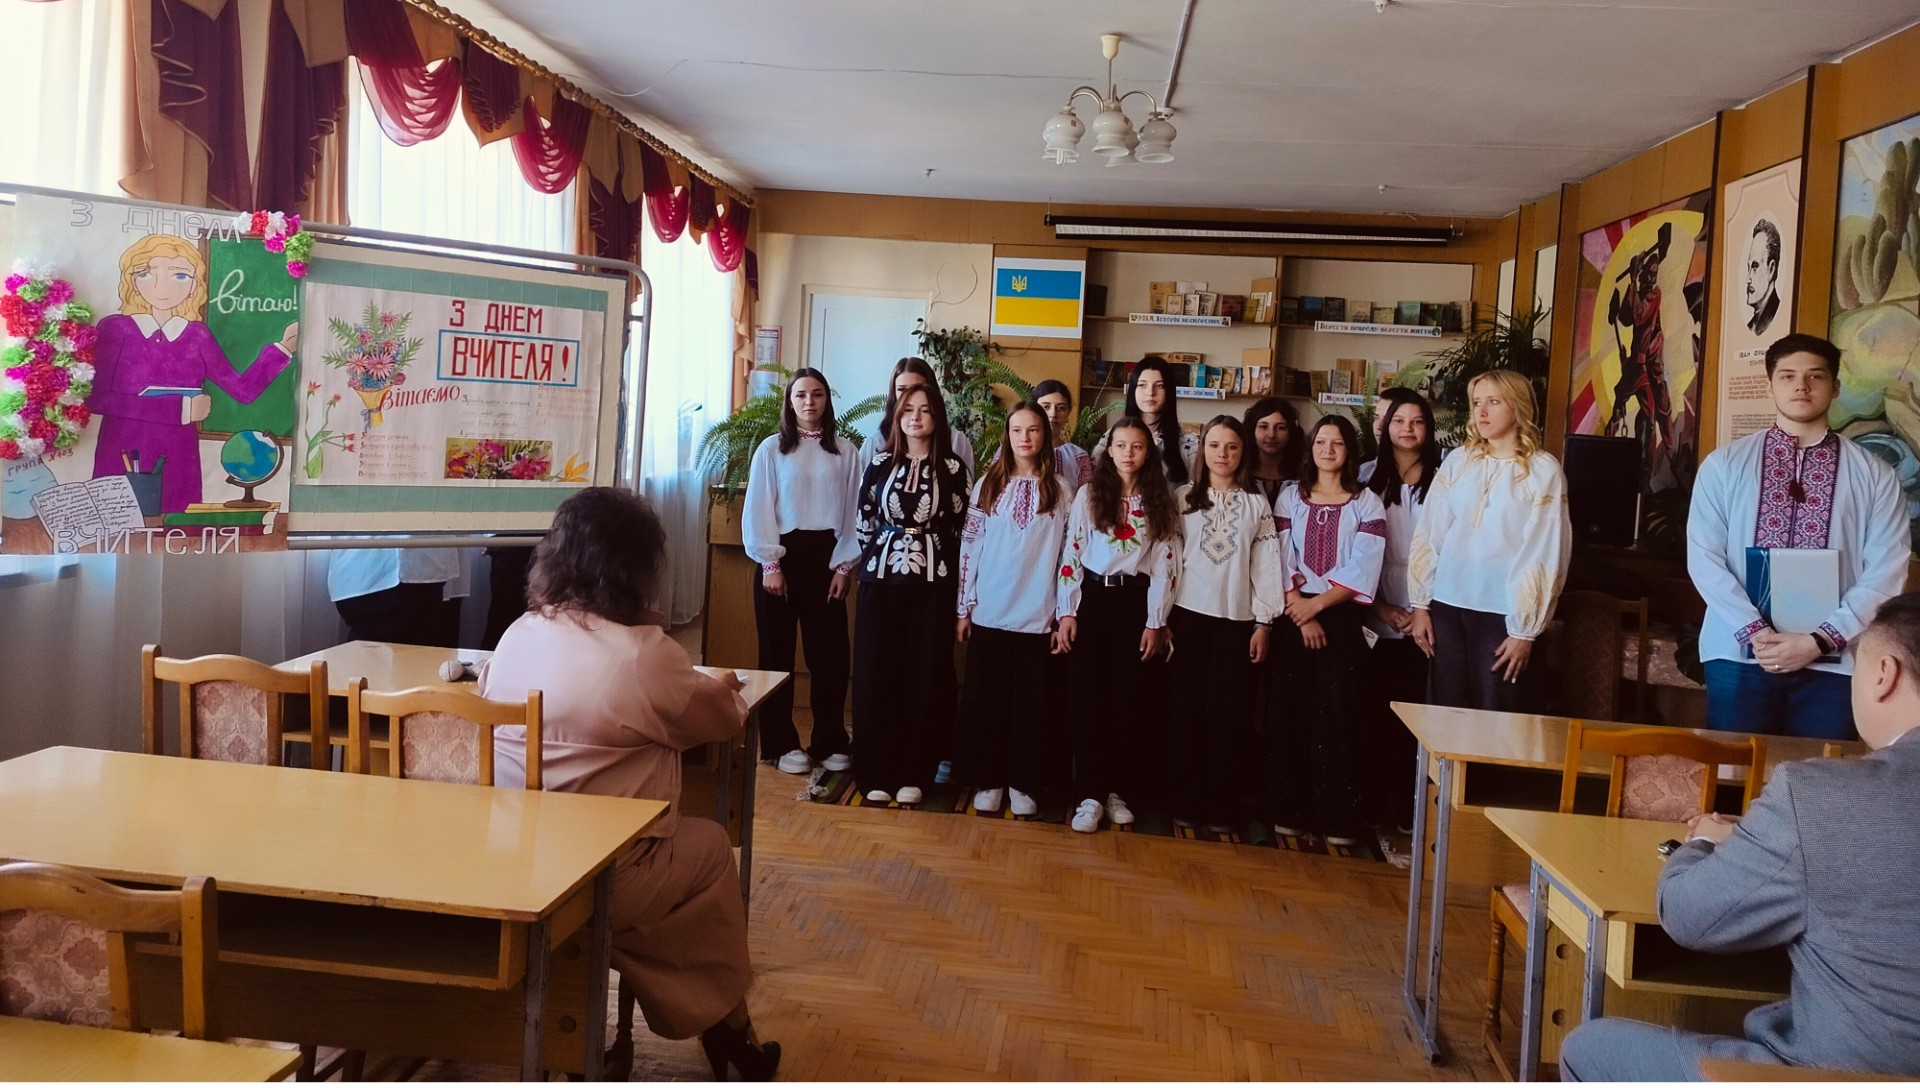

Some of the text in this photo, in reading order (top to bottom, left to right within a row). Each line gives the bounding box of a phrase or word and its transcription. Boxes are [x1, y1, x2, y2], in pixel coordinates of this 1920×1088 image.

[71, 200, 93, 227] З
[450, 300, 543, 334] З ДНЕМ
[378, 385, 461, 411] Вітаємо
[8, 458, 43, 477] ГРУПА
